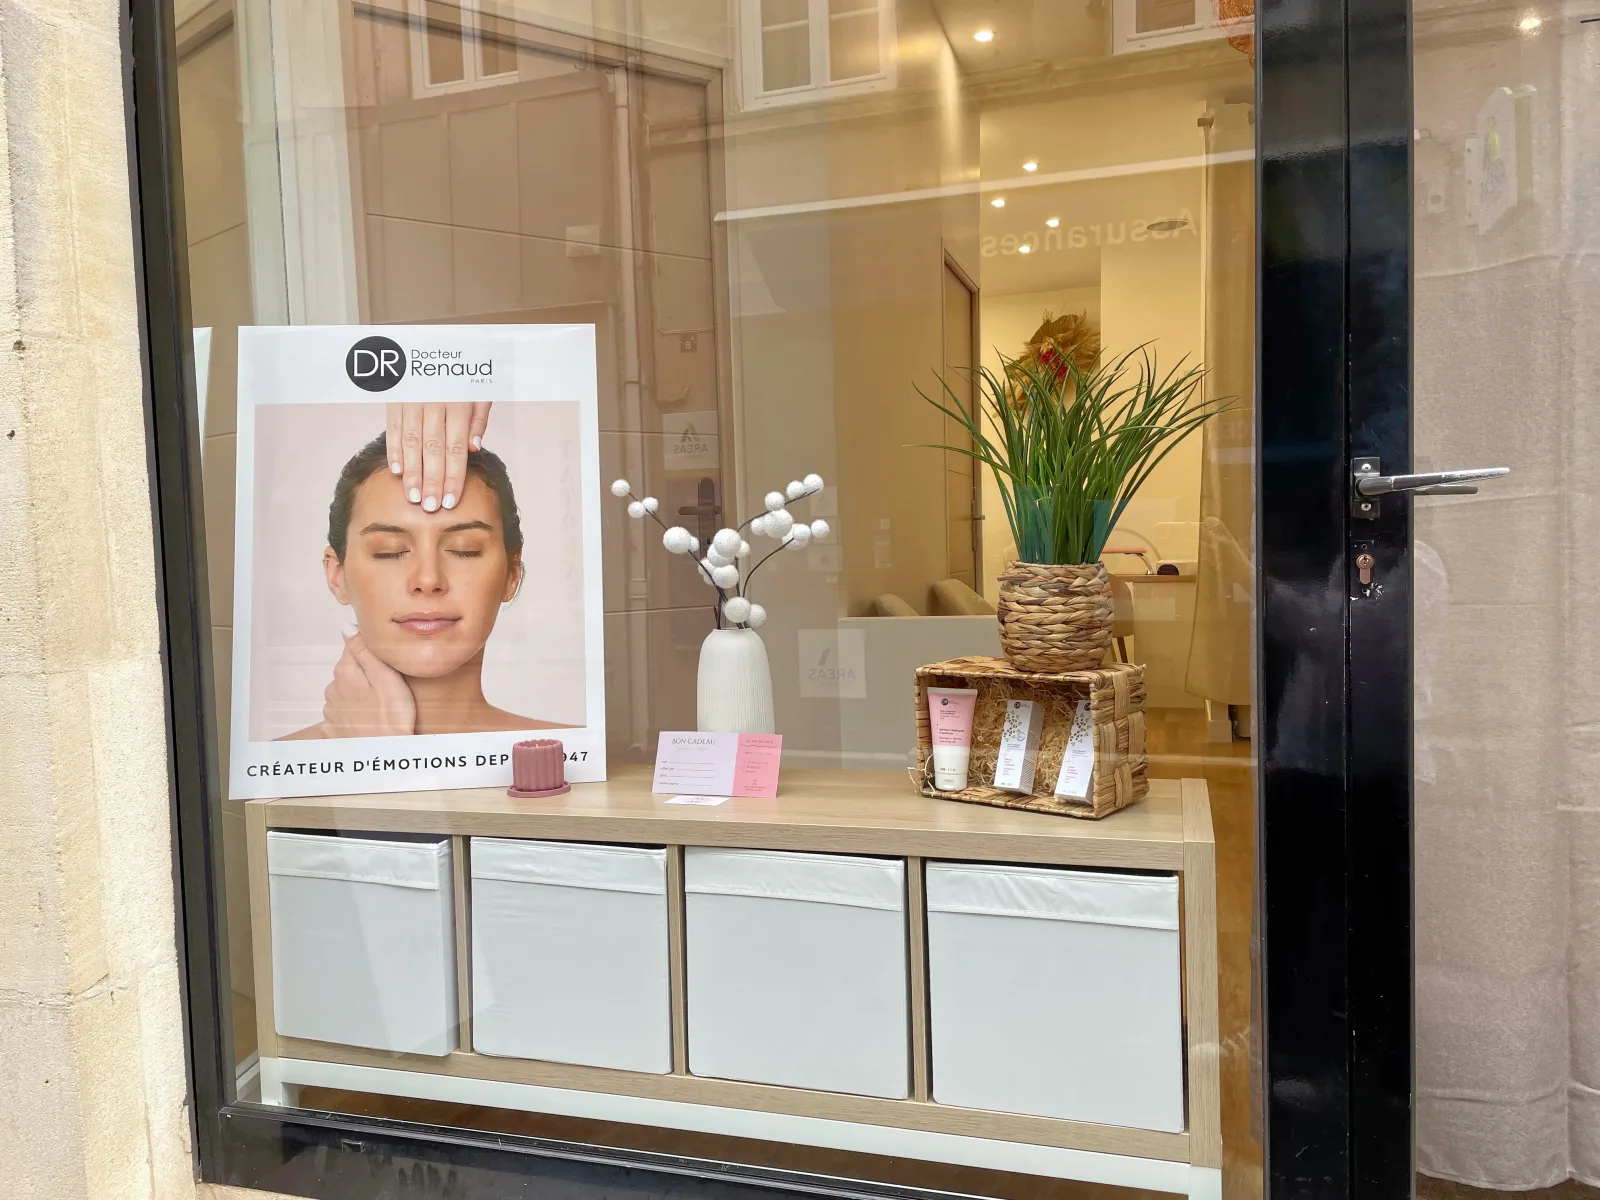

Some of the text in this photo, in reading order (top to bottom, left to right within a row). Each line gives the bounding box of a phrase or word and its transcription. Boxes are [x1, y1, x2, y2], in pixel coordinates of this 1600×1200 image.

[411, 349, 463, 359] Docteur
[353, 349, 400, 377] DR
[411, 359, 493, 376] Renaud
[671, 737, 717, 746] BON CADEAU
[246, 761, 345, 777] CRÉATEUR
[353, 756, 468, 772] D'ÉMOTIONS
[475, 753, 510, 767] DEP
